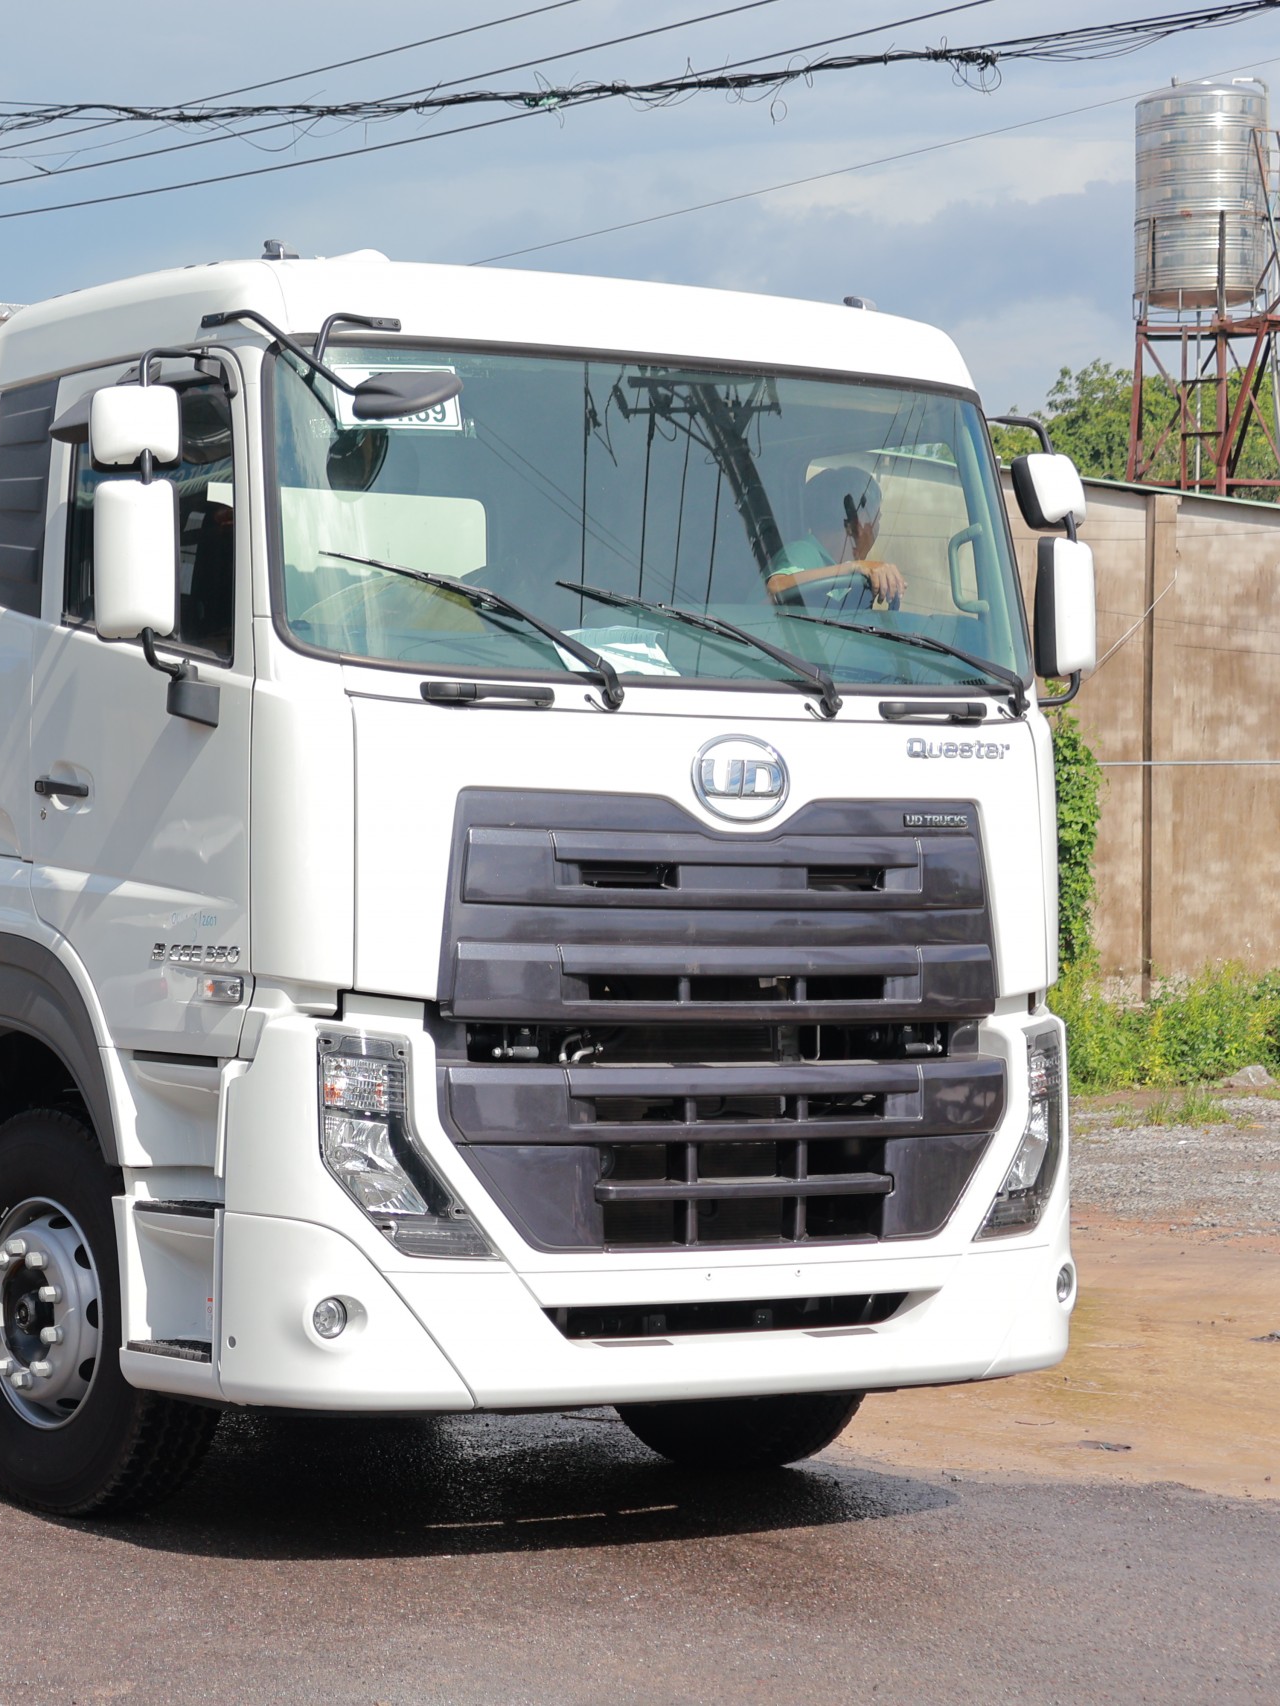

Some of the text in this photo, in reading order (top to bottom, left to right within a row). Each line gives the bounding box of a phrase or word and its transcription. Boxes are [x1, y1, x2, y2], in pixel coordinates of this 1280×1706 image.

[906, 737, 1011, 760] Quester
[700, 758, 785, 800] UD
[905, 814, 968, 826] UD TRUCKS
